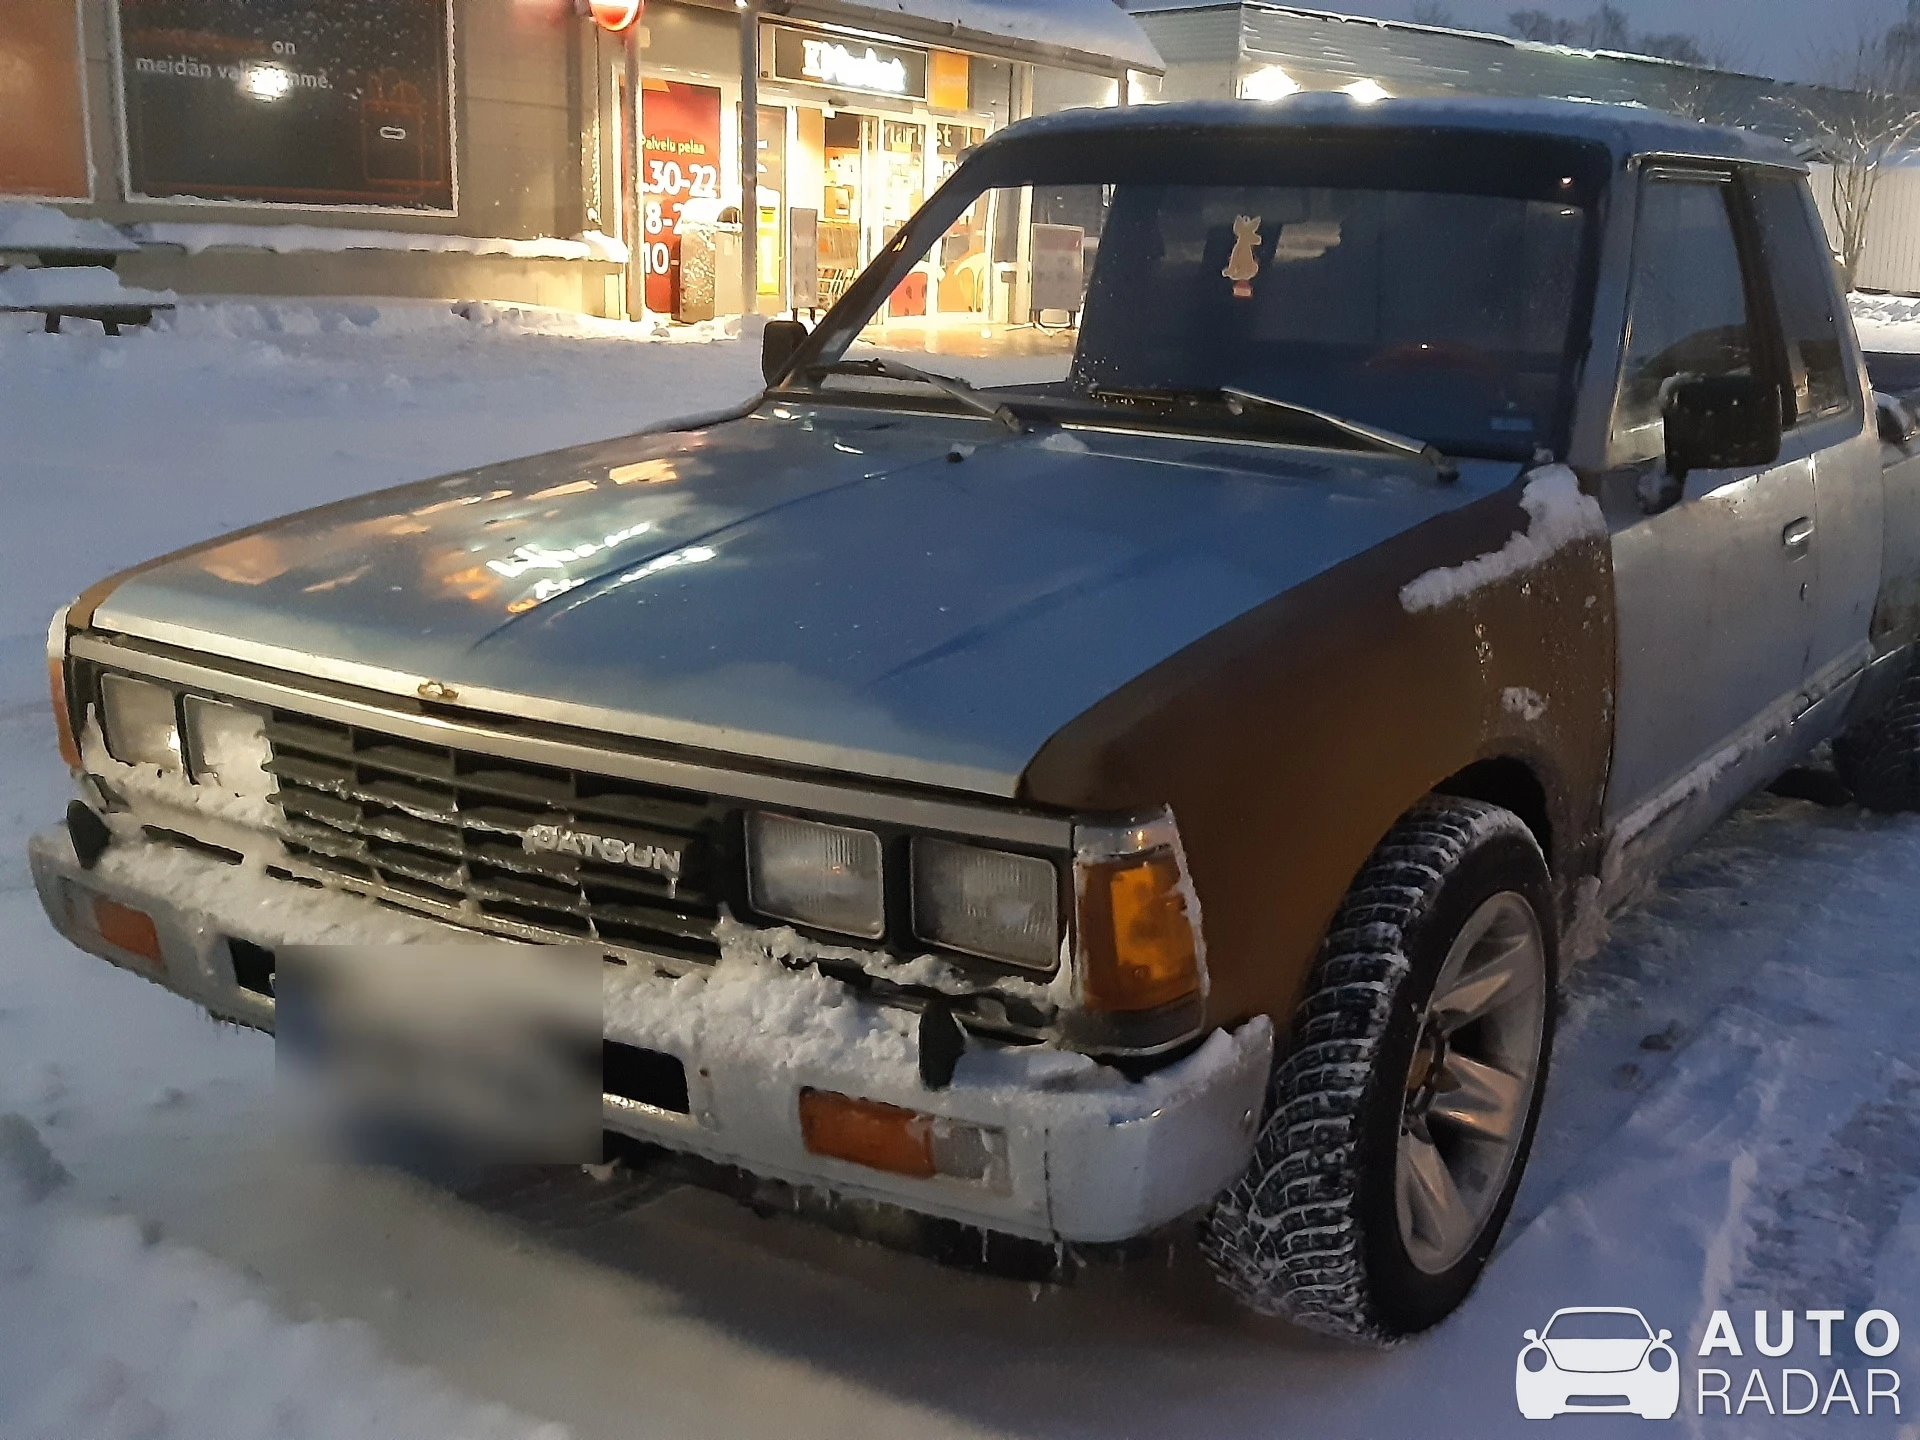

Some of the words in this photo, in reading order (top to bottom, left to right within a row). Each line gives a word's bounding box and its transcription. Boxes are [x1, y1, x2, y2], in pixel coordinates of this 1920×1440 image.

[271, 40, 297, 55] on
[135, 54, 212, 78] meidän
[641, 134, 676, 152] Palvelu
[678, 139, 706, 156] pelaa
[530, 824, 681, 873] DATSUN
